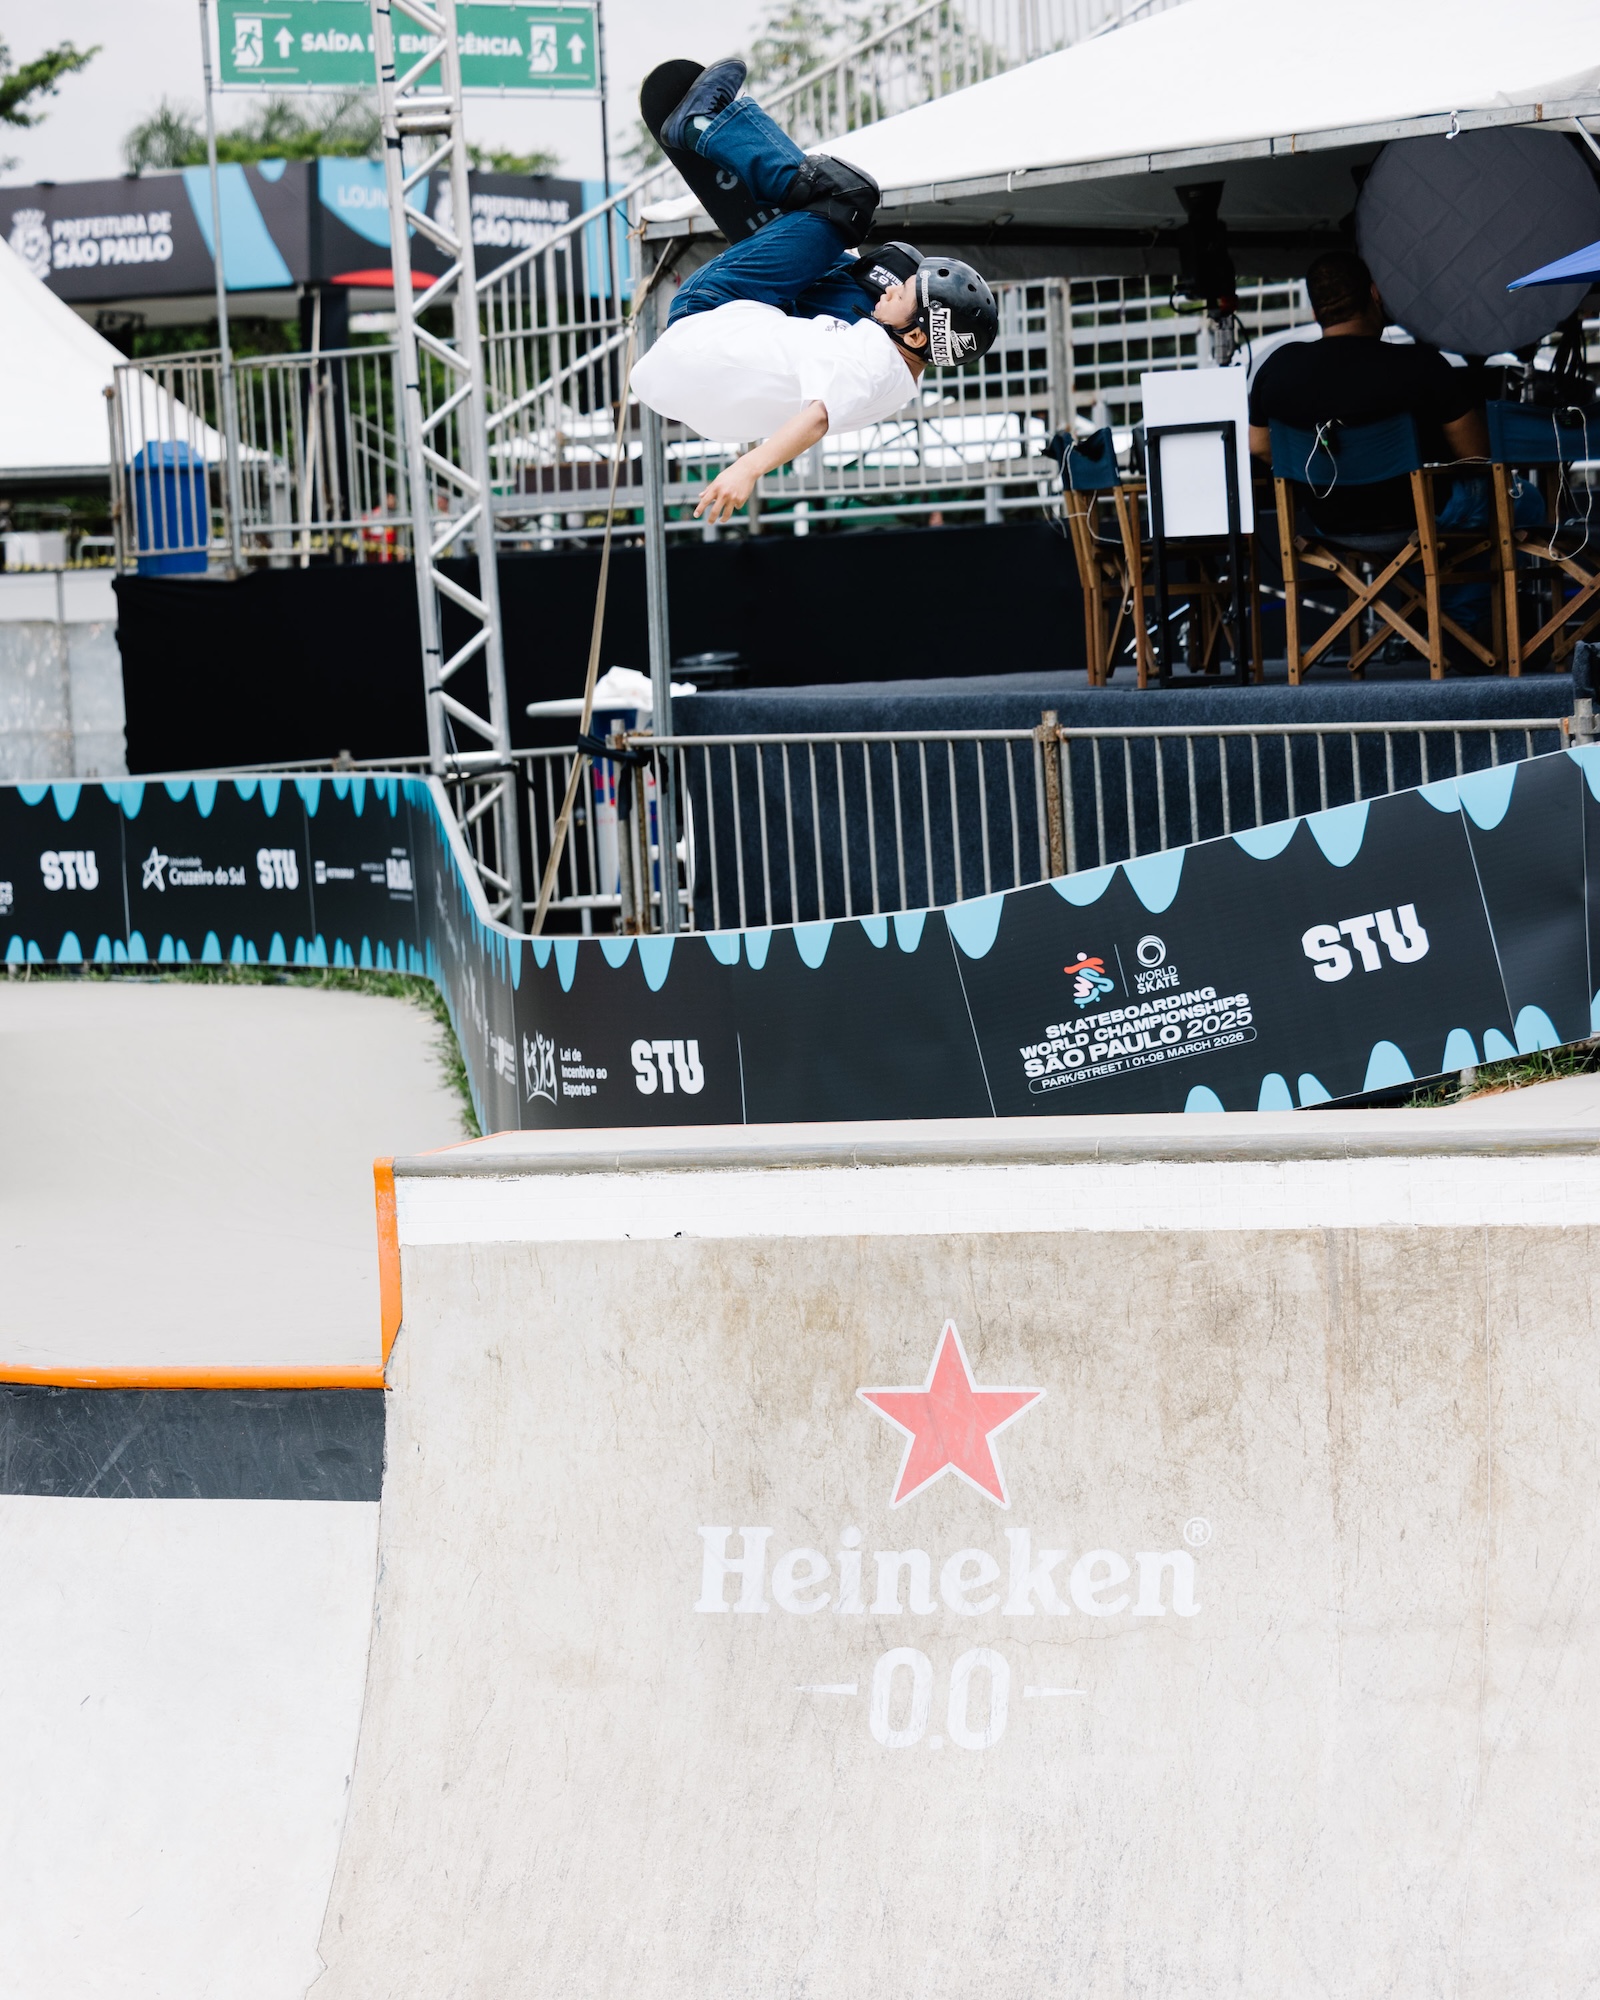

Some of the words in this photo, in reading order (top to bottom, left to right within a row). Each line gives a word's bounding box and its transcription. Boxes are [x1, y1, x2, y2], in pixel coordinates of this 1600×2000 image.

[301, 29, 364, 53] SAÍDA
[399, 32, 523, 56] EMEGÊNCIA
[52, 213, 148, 241] PREFEITURA
[147, 211, 172, 233] DE
[52, 235, 100, 269] SÃO
[100, 233, 174, 266] PAULO
[869, 272, 897, 287] 87
[932, 311, 948, 356] TREASURE
[40, 850, 99, 891] STU
[169, 866, 214, 886] Cruzeiro
[214, 866, 229, 886] do
[228, 866, 247, 886] Sul
[256, 848, 299, 890] STU
[1301, 902, 1430, 983] STU
[1134, 965, 1177, 984] WORLD
[1137, 974, 1180, 994] SKATE
[1019, 1032, 1090, 1060] WORLD
[1094, 993, 1250, 1042] CHAMPIONSHIPS
[1045, 986, 1217, 1040] SKATEBOARDING
[560, 1047, 571, 1062] Lei
[571, 1048, 582, 1062] de
[1023, 1049, 1086, 1079] SÃO
[1088, 1024, 1183, 1063] PAULO
[1186, 1006, 1254, 1040] 2025
[1041, 1061, 1123, 1090] PARK/STREET
[1132, 1051, 1165, 1068] 01-08
[1166, 1040, 1212, 1060] MARCH
[1213, 1031, 1246, 1047] 2026
[561, 1065, 595, 1079] Incentivo
[596, 1067, 608, 1079] ao
[630, 1039, 705, 1095] STU
[562, 1081, 591, 1098] Esporte
[694, 1524, 1201, 1618] Heineken
[869, 1645, 1011, 1751] 0.0
